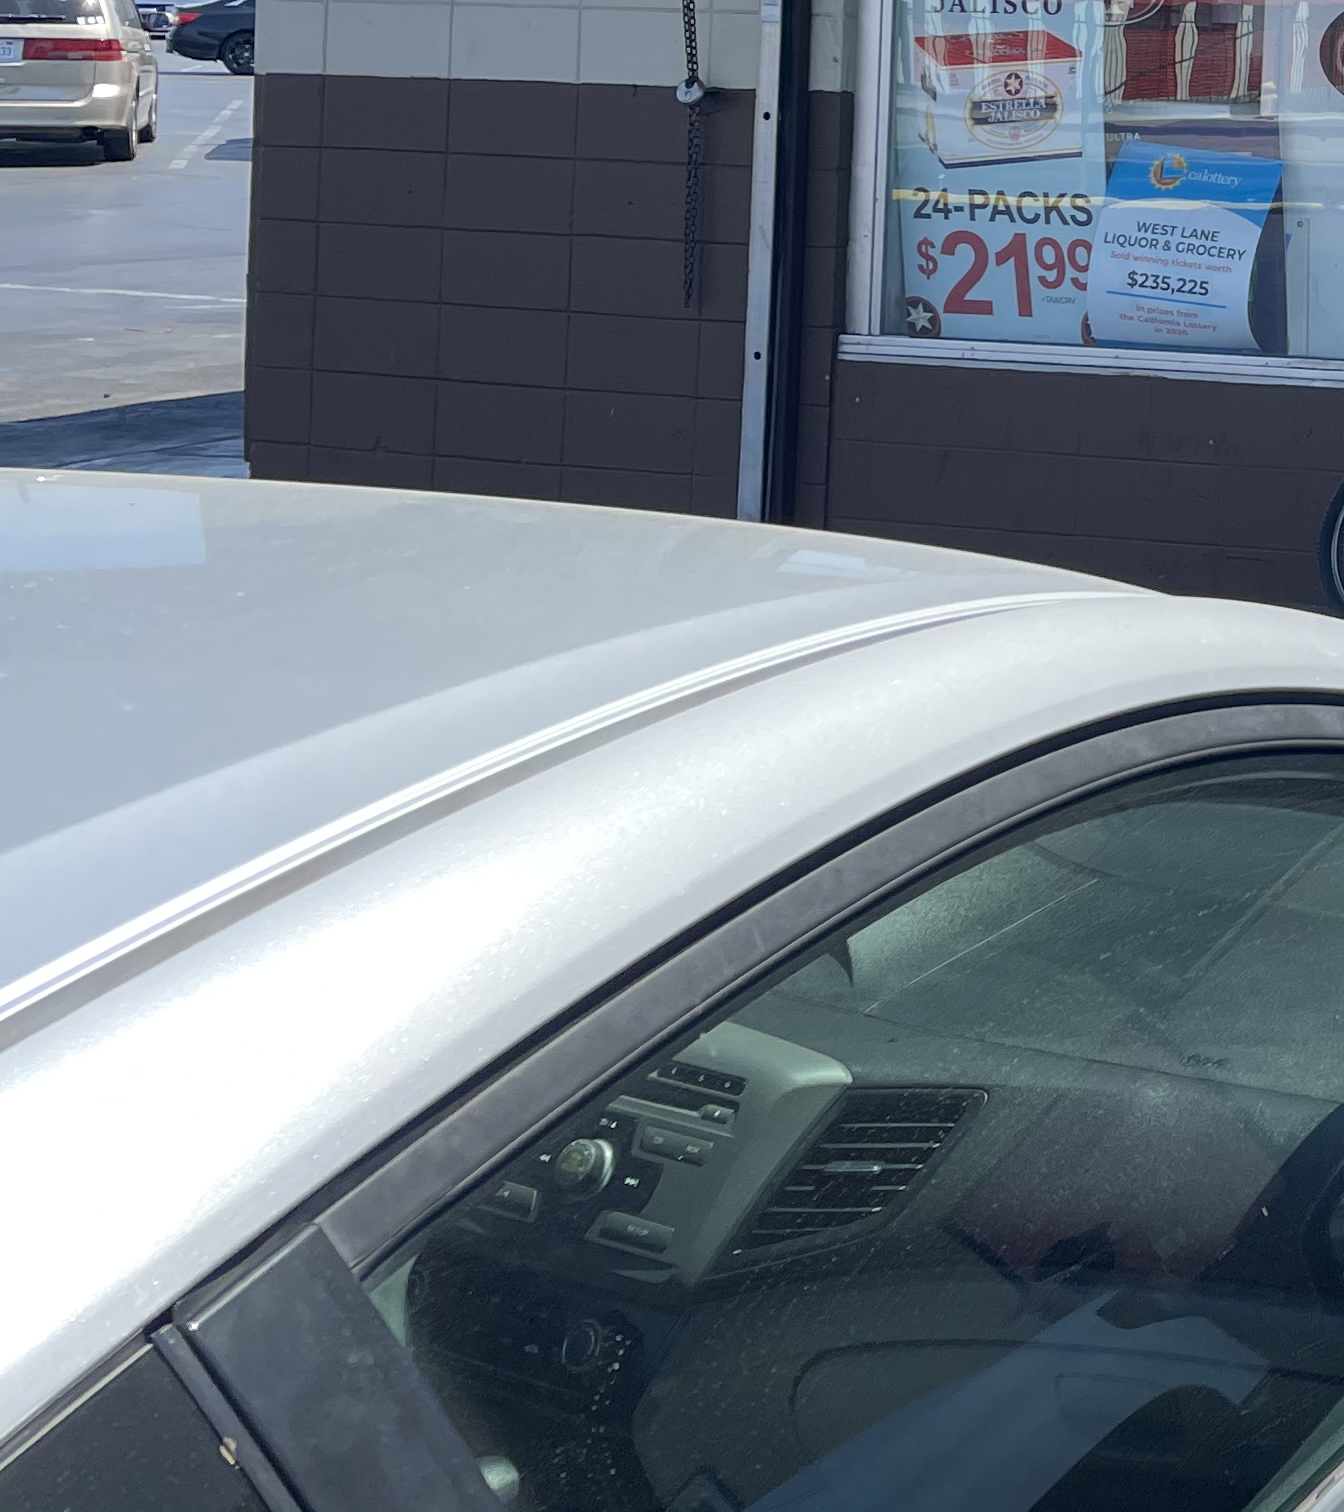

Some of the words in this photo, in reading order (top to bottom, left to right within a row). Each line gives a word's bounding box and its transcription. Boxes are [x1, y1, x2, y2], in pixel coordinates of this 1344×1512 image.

[981, 98, 1047, 114] ESTRELLA
[988, 108, 1041, 123] JALISCO
[1188, 169, 1243, 189] calottery
[912, 186, 1094, 227] 24-PACKS
[1136, 220, 1179, 238] WEST
[1180, 226, 1221, 242] LANE
[1103, 231, 1160, 251] LIQUOR
[1162, 240, 1172, 252] &
[1175, 241, 1247, 262] GROCERY
[1111, 250, 1131, 260] Sold
[1132, 253, 1170, 267] winning
[1171, 257, 1203, 270] tickets
[1204, 262, 1233, 274] worth
[1127, 269, 1210, 297] $235,225
[1146, 305, 1175, 317] prizes
[1176, 309, 1199, 319] from
[1136, 314, 1181, 327] California
[1183, 321, 1218, 332] Lottery
